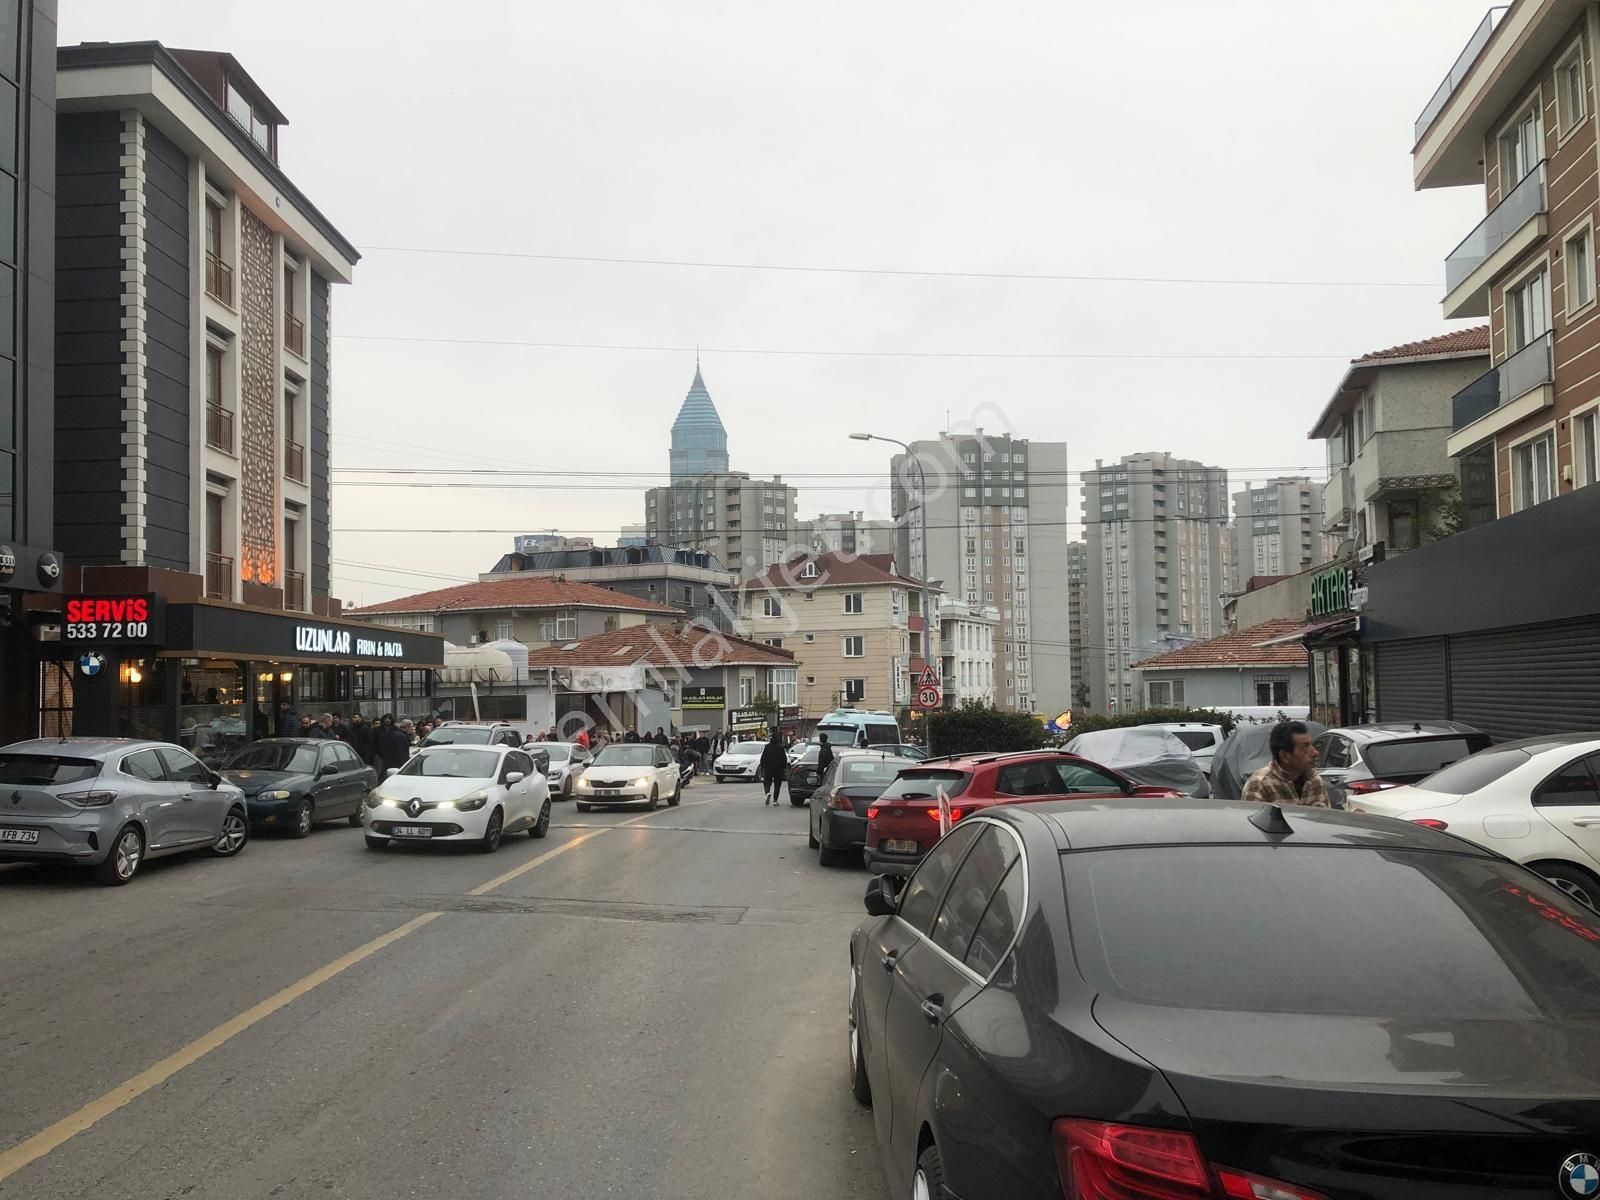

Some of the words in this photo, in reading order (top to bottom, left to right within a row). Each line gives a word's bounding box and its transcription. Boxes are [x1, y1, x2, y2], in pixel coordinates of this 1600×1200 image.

[1311, 566, 1348, 616] AKTAR
[67, 623, 96, 638] 533
[102, 623, 122, 638] 72
[127, 622, 147, 638] 00
[296, 626, 350, 654] UZUNLAR
[356, 638, 376, 656] FIRIN
[377, 641, 383, 657] &
[921, 692, 935, 703] 30
[20, 831, 36, 841] 734
